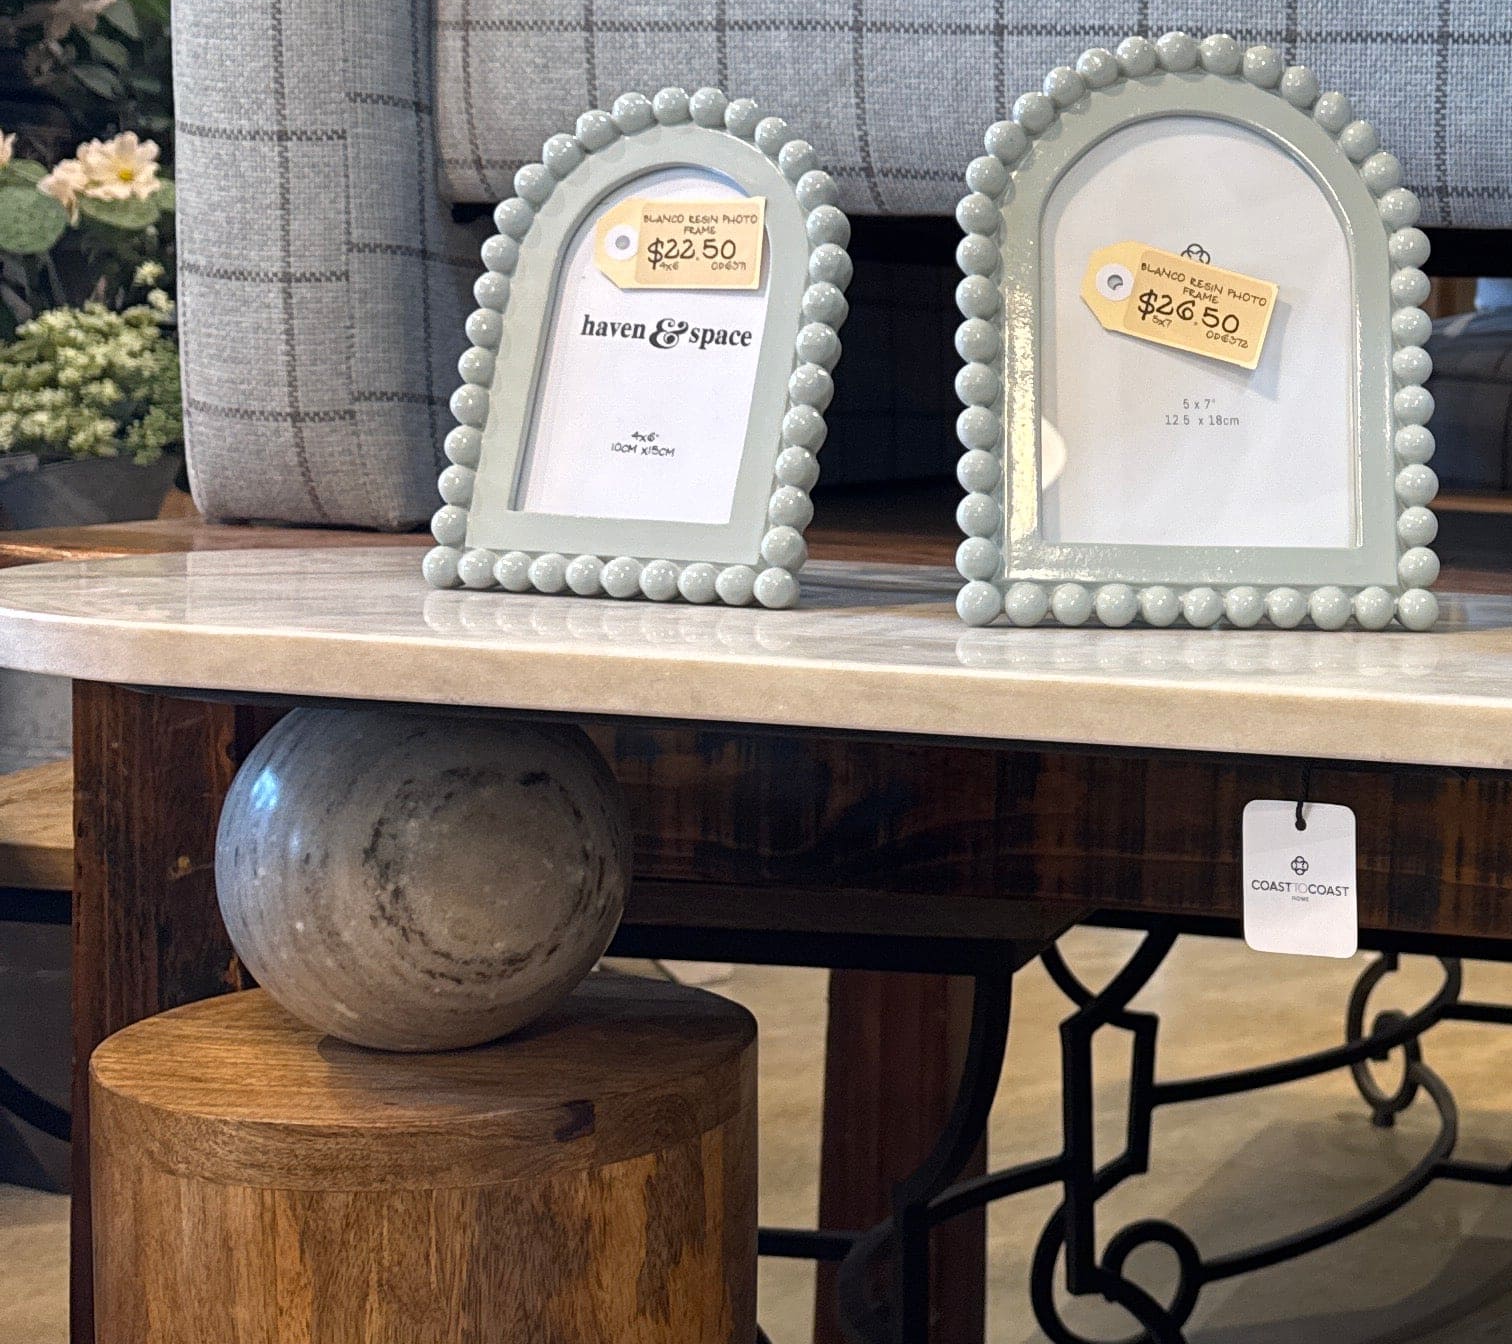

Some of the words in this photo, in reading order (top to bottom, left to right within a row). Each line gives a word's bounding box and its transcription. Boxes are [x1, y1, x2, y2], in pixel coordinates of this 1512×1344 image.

[643, 214, 685, 224] BLANCO
[688, 214, 719, 225] RESIN
[722, 214, 758, 225] PHOTO
[683, 225, 717, 236] FRAME
[647, 237, 737, 271] $22.50
[1140, 262, 1186, 283] BLANCO
[1189, 277, 1225, 295] RESIN
[1227, 288, 1268, 307] PHOTO
[1182, 286, 1220, 305] FRAME
[1137, 288, 1240, 334] $26.50
[580, 313, 647, 340] haven
[688, 326, 753, 351] space
[1182, 398, 1190, 410] 5
[1208, 414, 1240, 426] 18cm
[1291, 895, 1310, 903] HOME
